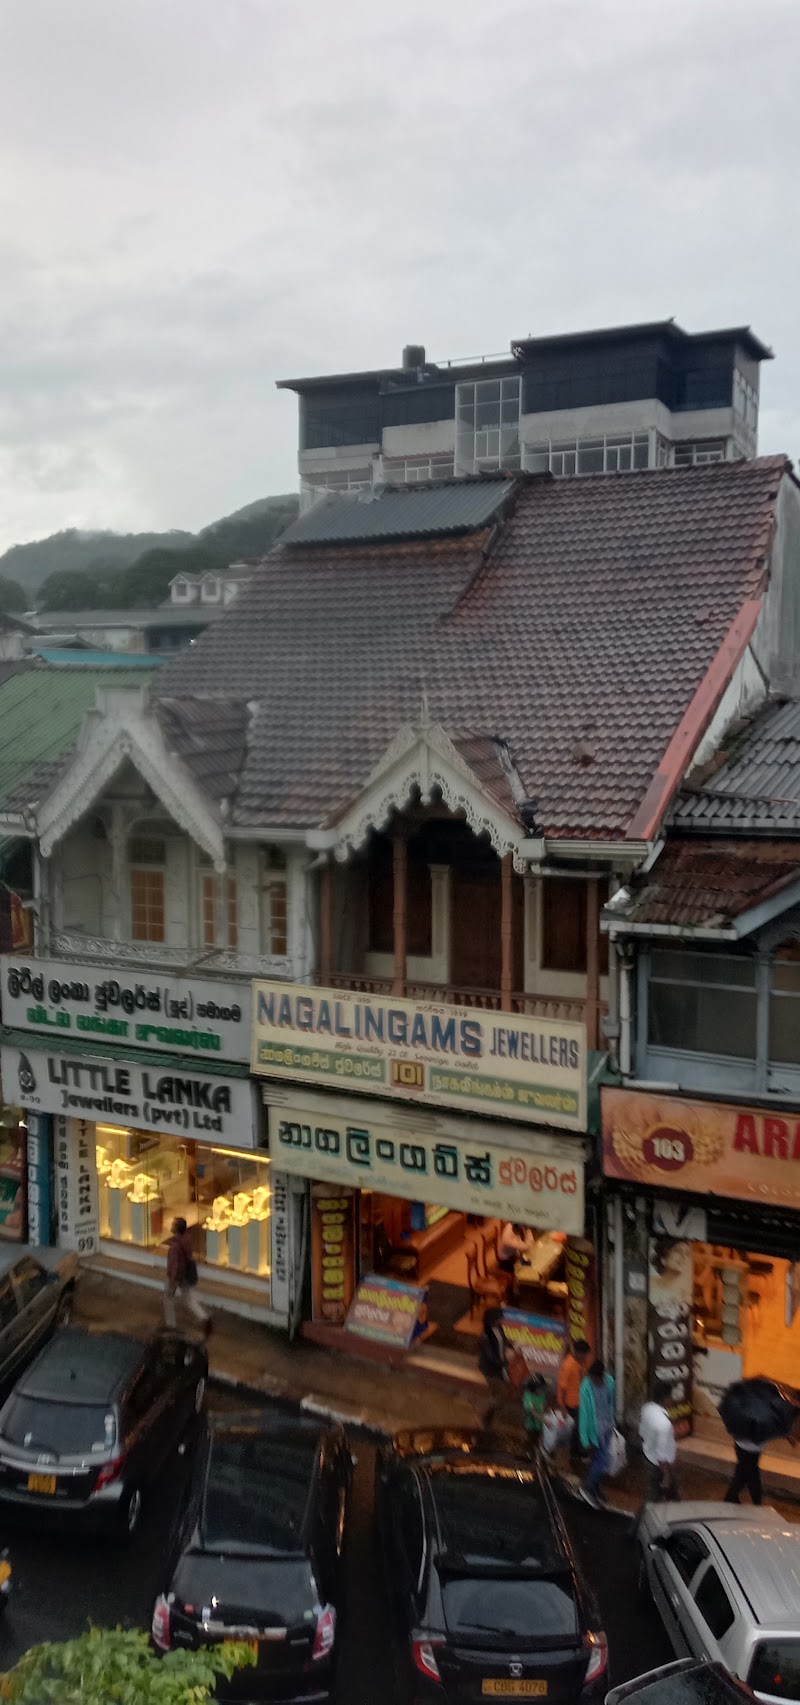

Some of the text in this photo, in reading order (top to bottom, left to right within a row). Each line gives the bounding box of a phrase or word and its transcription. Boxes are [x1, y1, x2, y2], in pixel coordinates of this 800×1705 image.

[257, 990, 580, 1070] NAGALINGAMS JEWELLERS
[47, 1058, 231, 1114] LITTLE LANKA
[143, 1101, 189, 1129] (pvt)
[193, 1111, 223, 1133] Ltd
[651, 1136, 686, 1162] 103
[78, 1237, 94, 1252] 99
